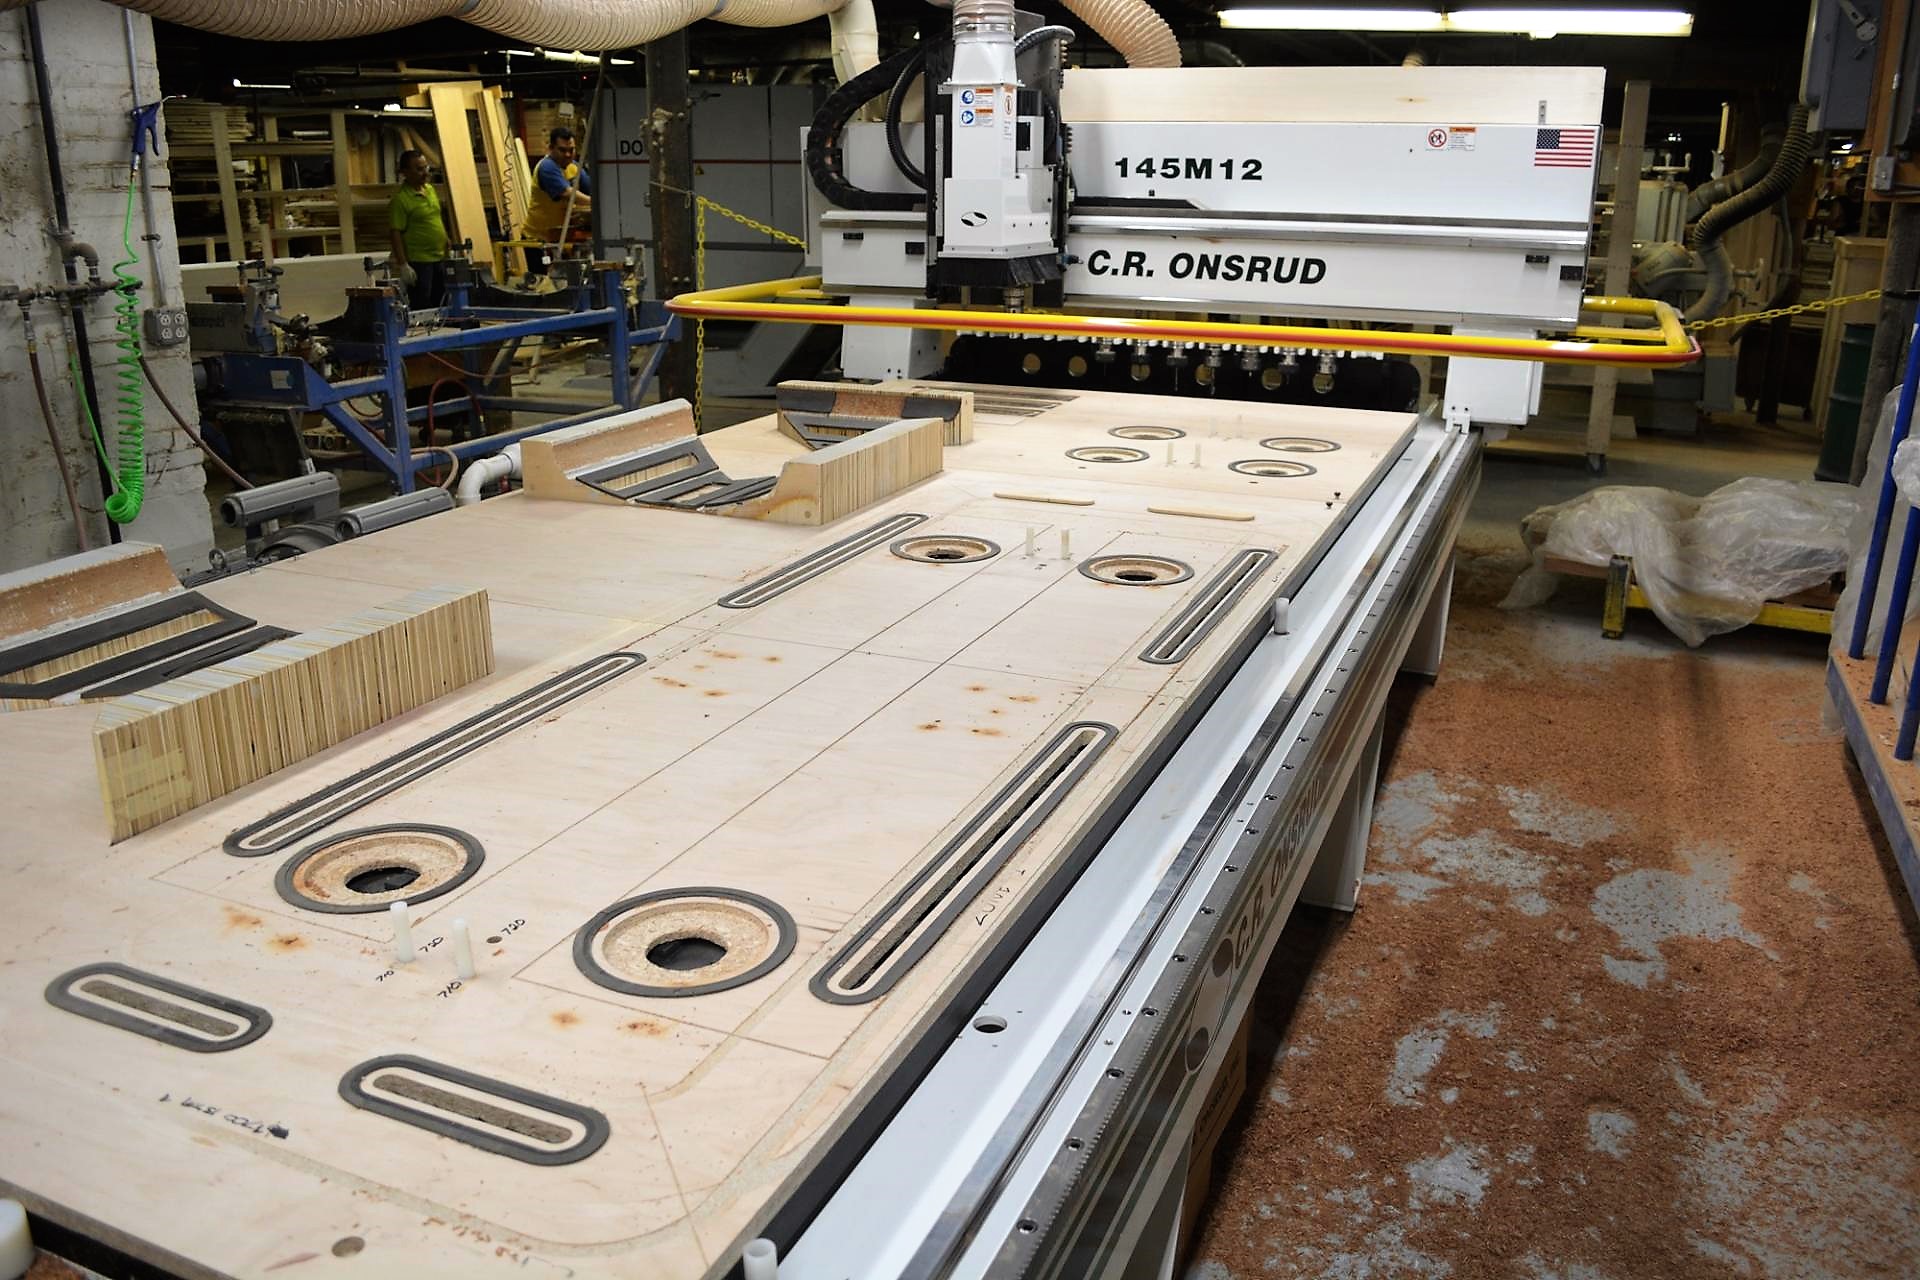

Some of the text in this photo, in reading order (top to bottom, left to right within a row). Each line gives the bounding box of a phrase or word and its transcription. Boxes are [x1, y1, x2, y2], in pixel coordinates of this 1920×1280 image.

[1114, 157, 1263, 181] 145M12
[1087, 249, 1327, 285] C.R. ONSRUD
